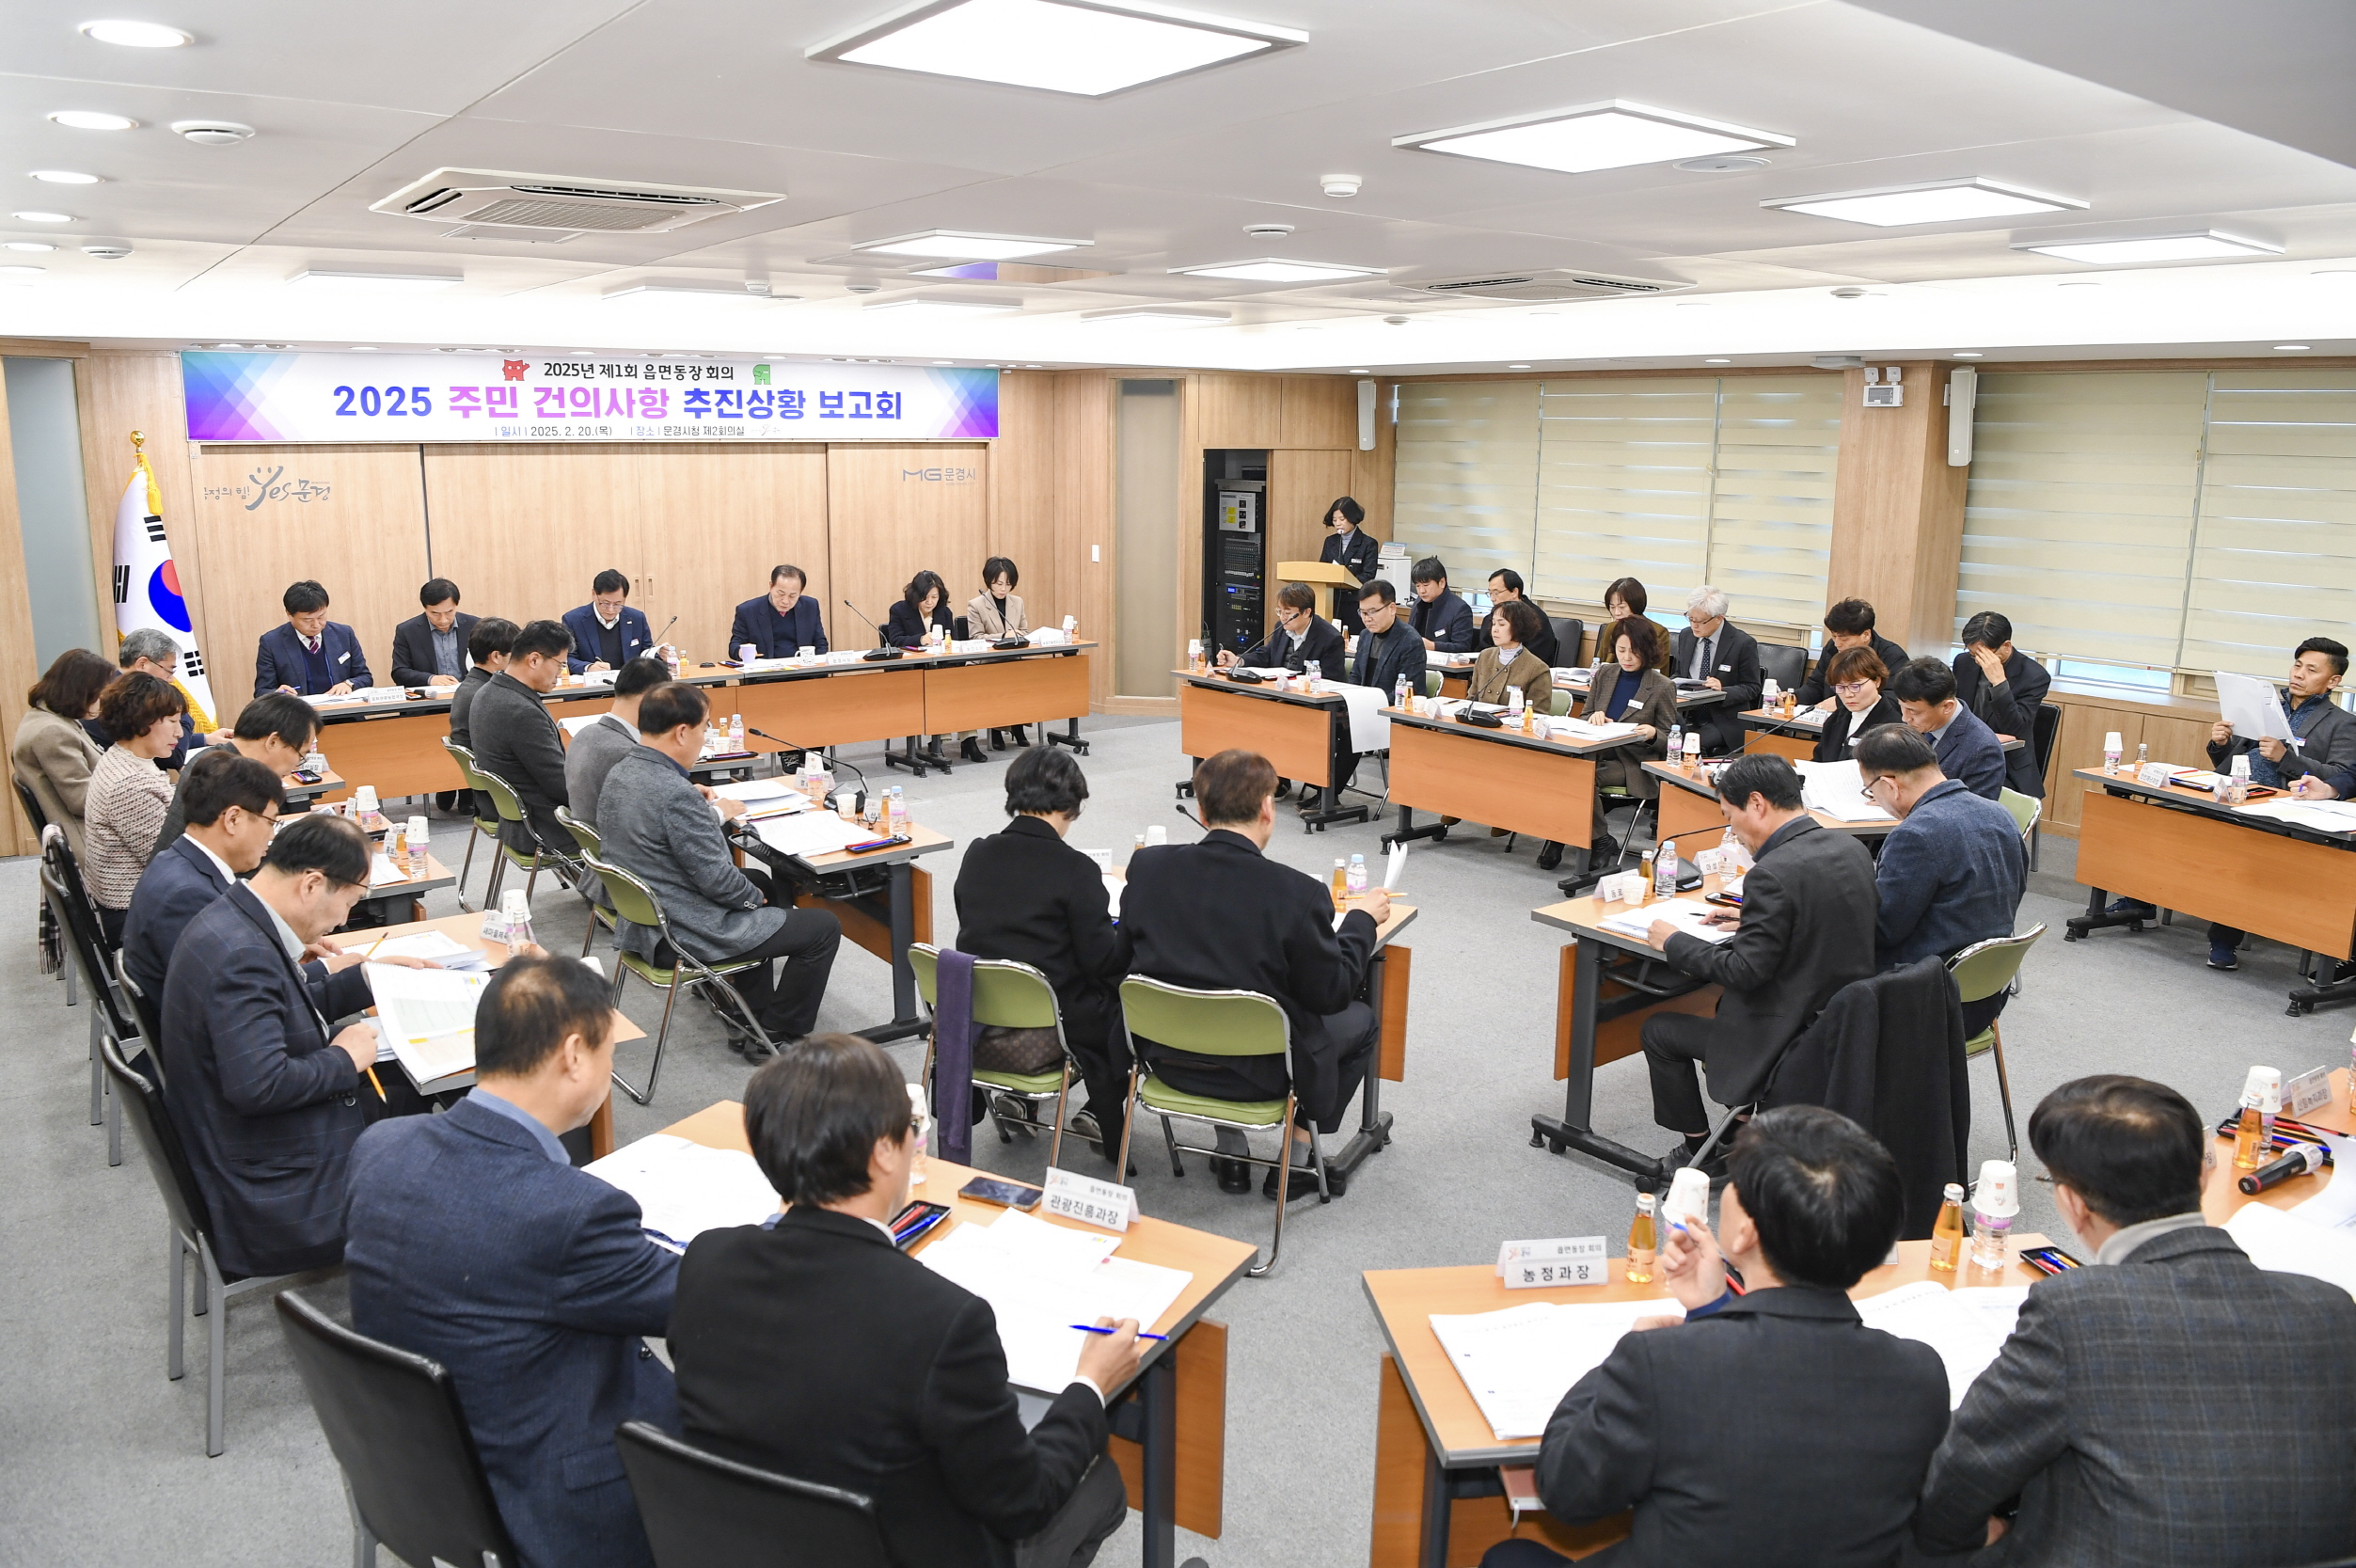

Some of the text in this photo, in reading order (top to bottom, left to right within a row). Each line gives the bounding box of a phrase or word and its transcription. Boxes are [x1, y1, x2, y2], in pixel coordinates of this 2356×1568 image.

[544, 362, 735, 382] 2025년 제1회 읍면동장 회의
[334, 386, 902, 420] 2025 주민 건의사항 추진상황 보고회
[500, 426, 521, 437] 일시
[530, 426, 561, 436] 2025.
[564, 426, 575, 436] 2.
[636, 426, 656, 436] 장소
[663, 426, 700, 436] 문경시청
[703, 426, 745, 436] 제2회의실
[903, 467, 976, 482] MG 문경시
[1050, 1194, 1118, 1225] 관광진흥과장
[1522, 1264, 1590, 1283] 농정과장
